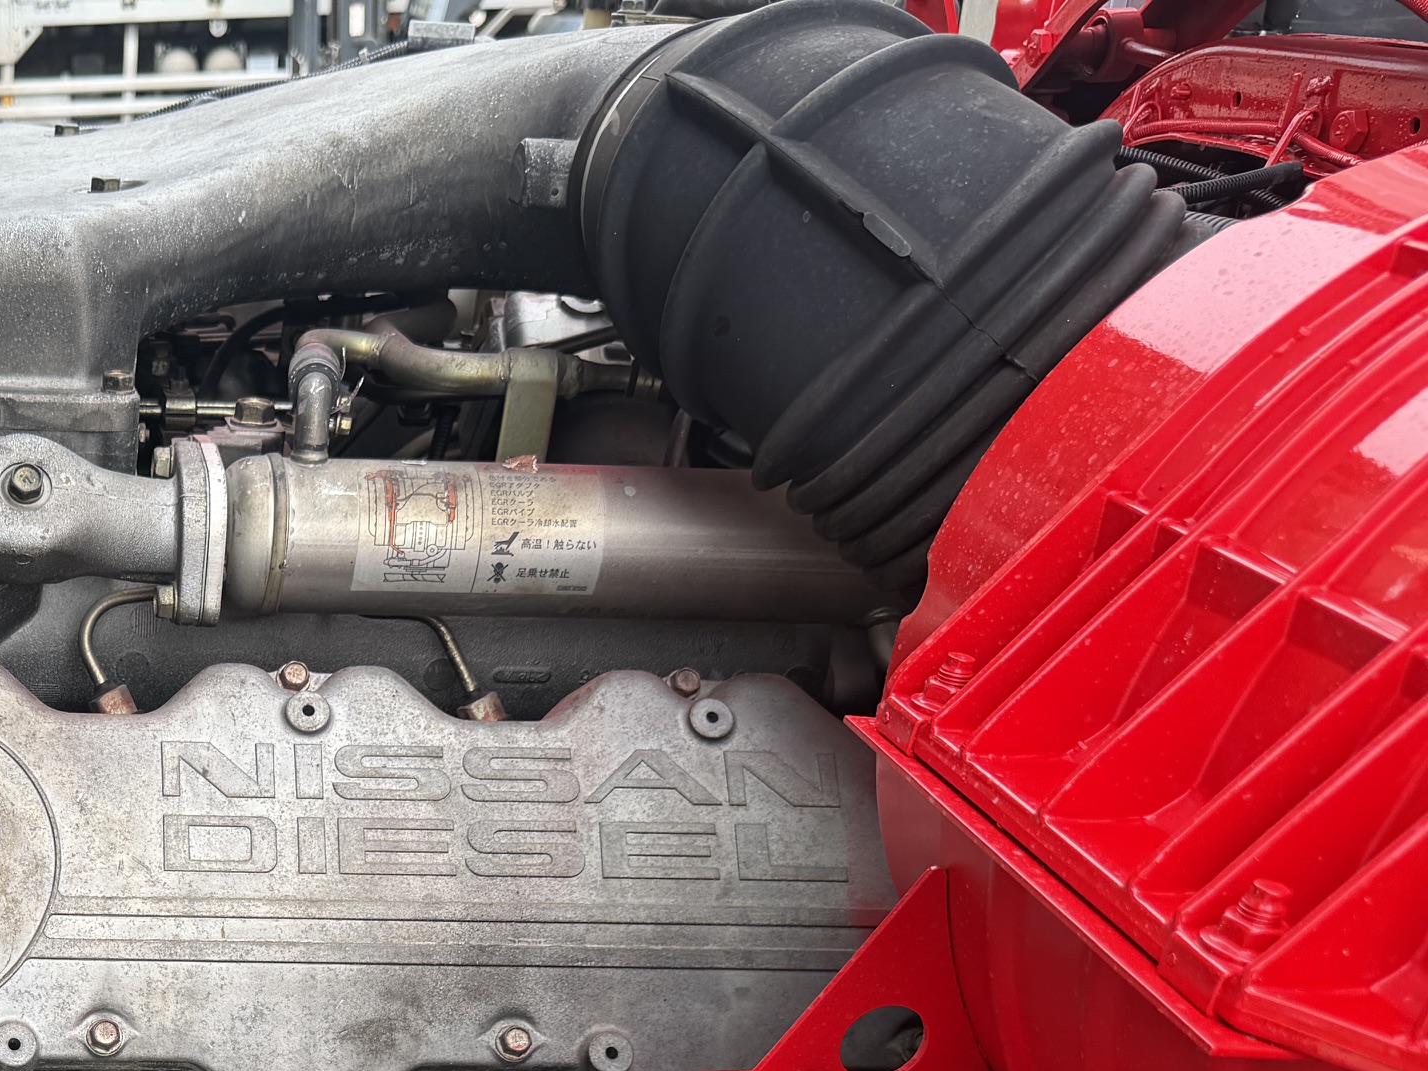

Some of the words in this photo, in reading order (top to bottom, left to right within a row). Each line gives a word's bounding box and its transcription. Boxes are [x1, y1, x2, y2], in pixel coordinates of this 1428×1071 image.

[515, 567, 570, 579] 足乗せ禁止
[160, 740, 841, 808] NISSAN
[163, 814, 849, 883] DIESEL
